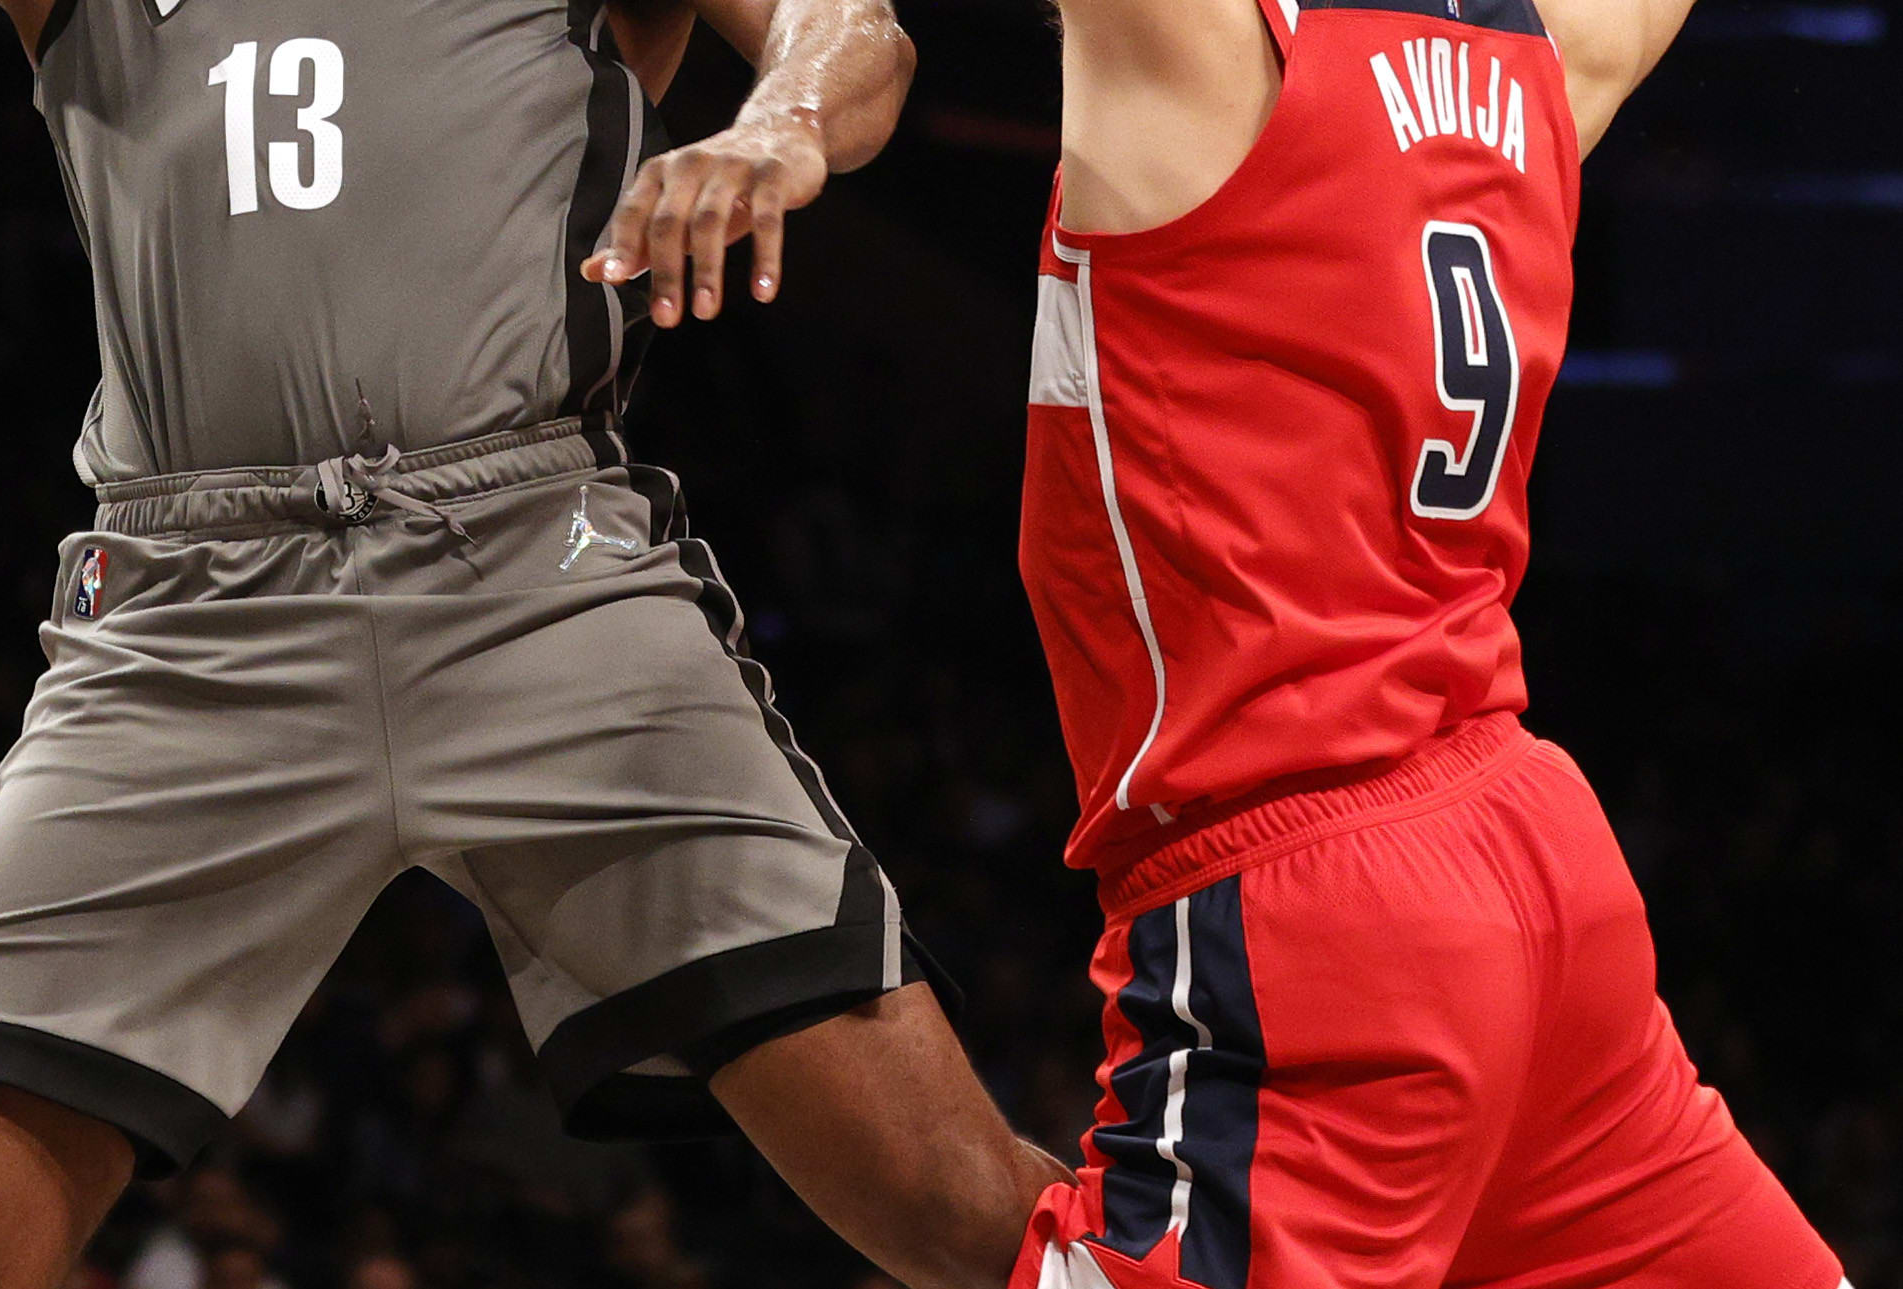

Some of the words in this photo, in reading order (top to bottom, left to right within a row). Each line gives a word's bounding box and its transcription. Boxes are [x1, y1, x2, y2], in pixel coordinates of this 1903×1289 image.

[207, 38, 344, 216] 13
[1369, 36, 1526, 174] AVDIJA
[1410, 220, 1519, 521] 9
